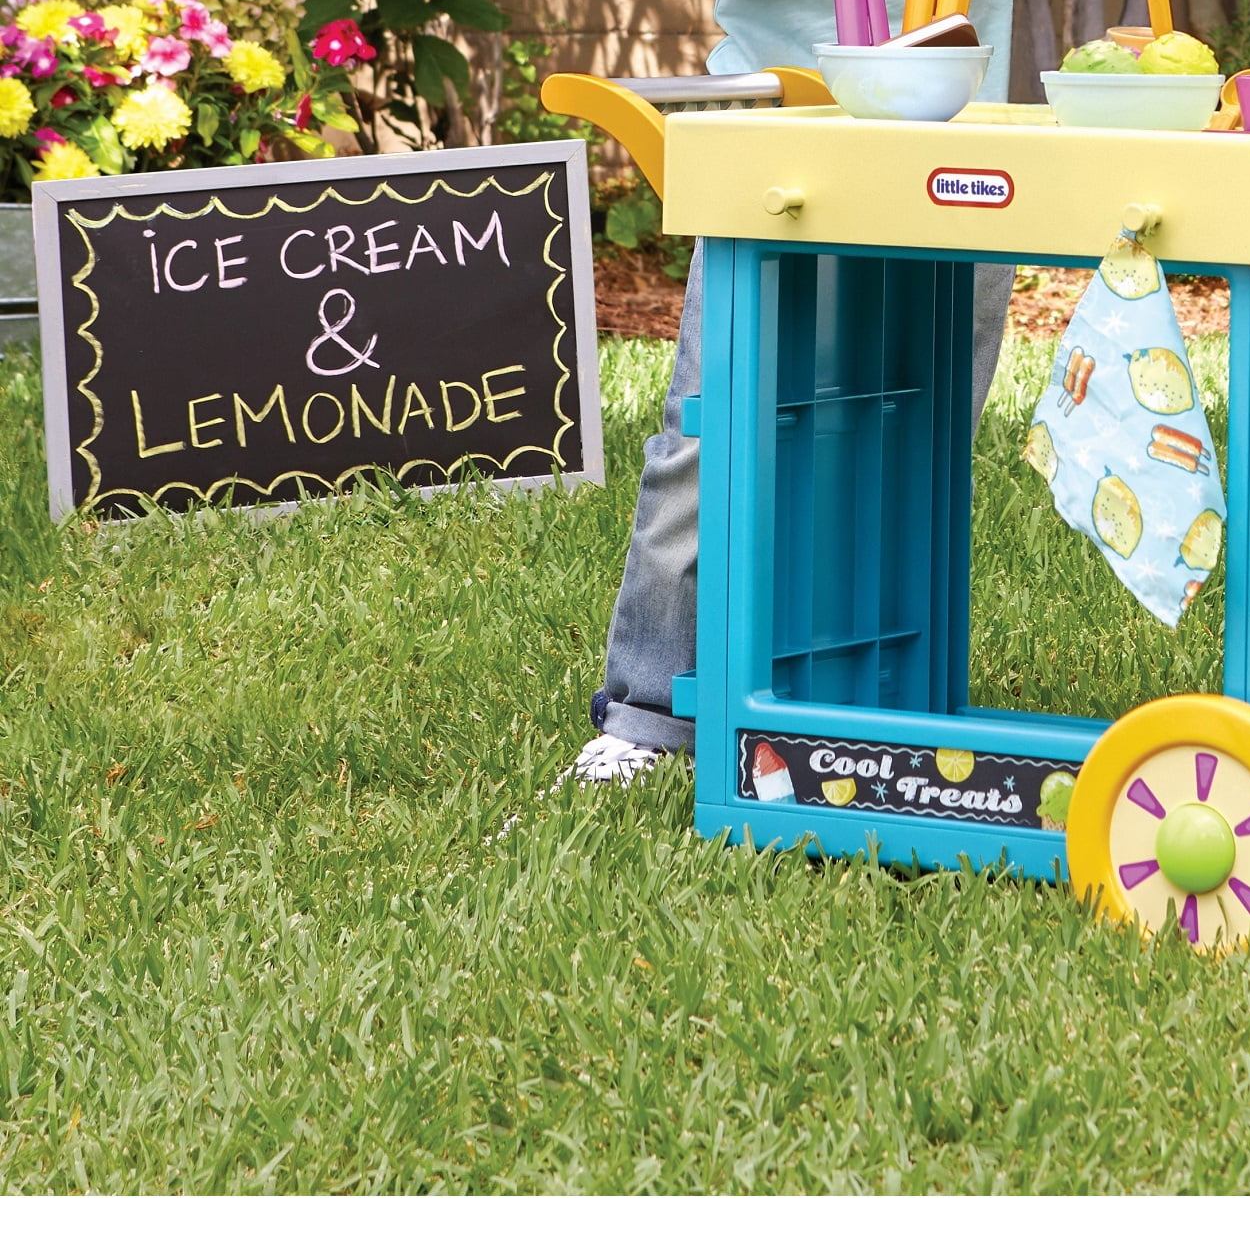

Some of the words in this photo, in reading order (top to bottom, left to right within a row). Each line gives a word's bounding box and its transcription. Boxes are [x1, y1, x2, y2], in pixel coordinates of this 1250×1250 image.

[936, 178, 969, 195] little
[971, 180, 1004, 197] tikes
[280, 210, 510, 280] CREAM
[305, 288, 381, 377] &
[131, 364, 527, 459] LEMONADE
[808, 748, 895, 780] Cool
[896, 776, 1023, 814] Treats
